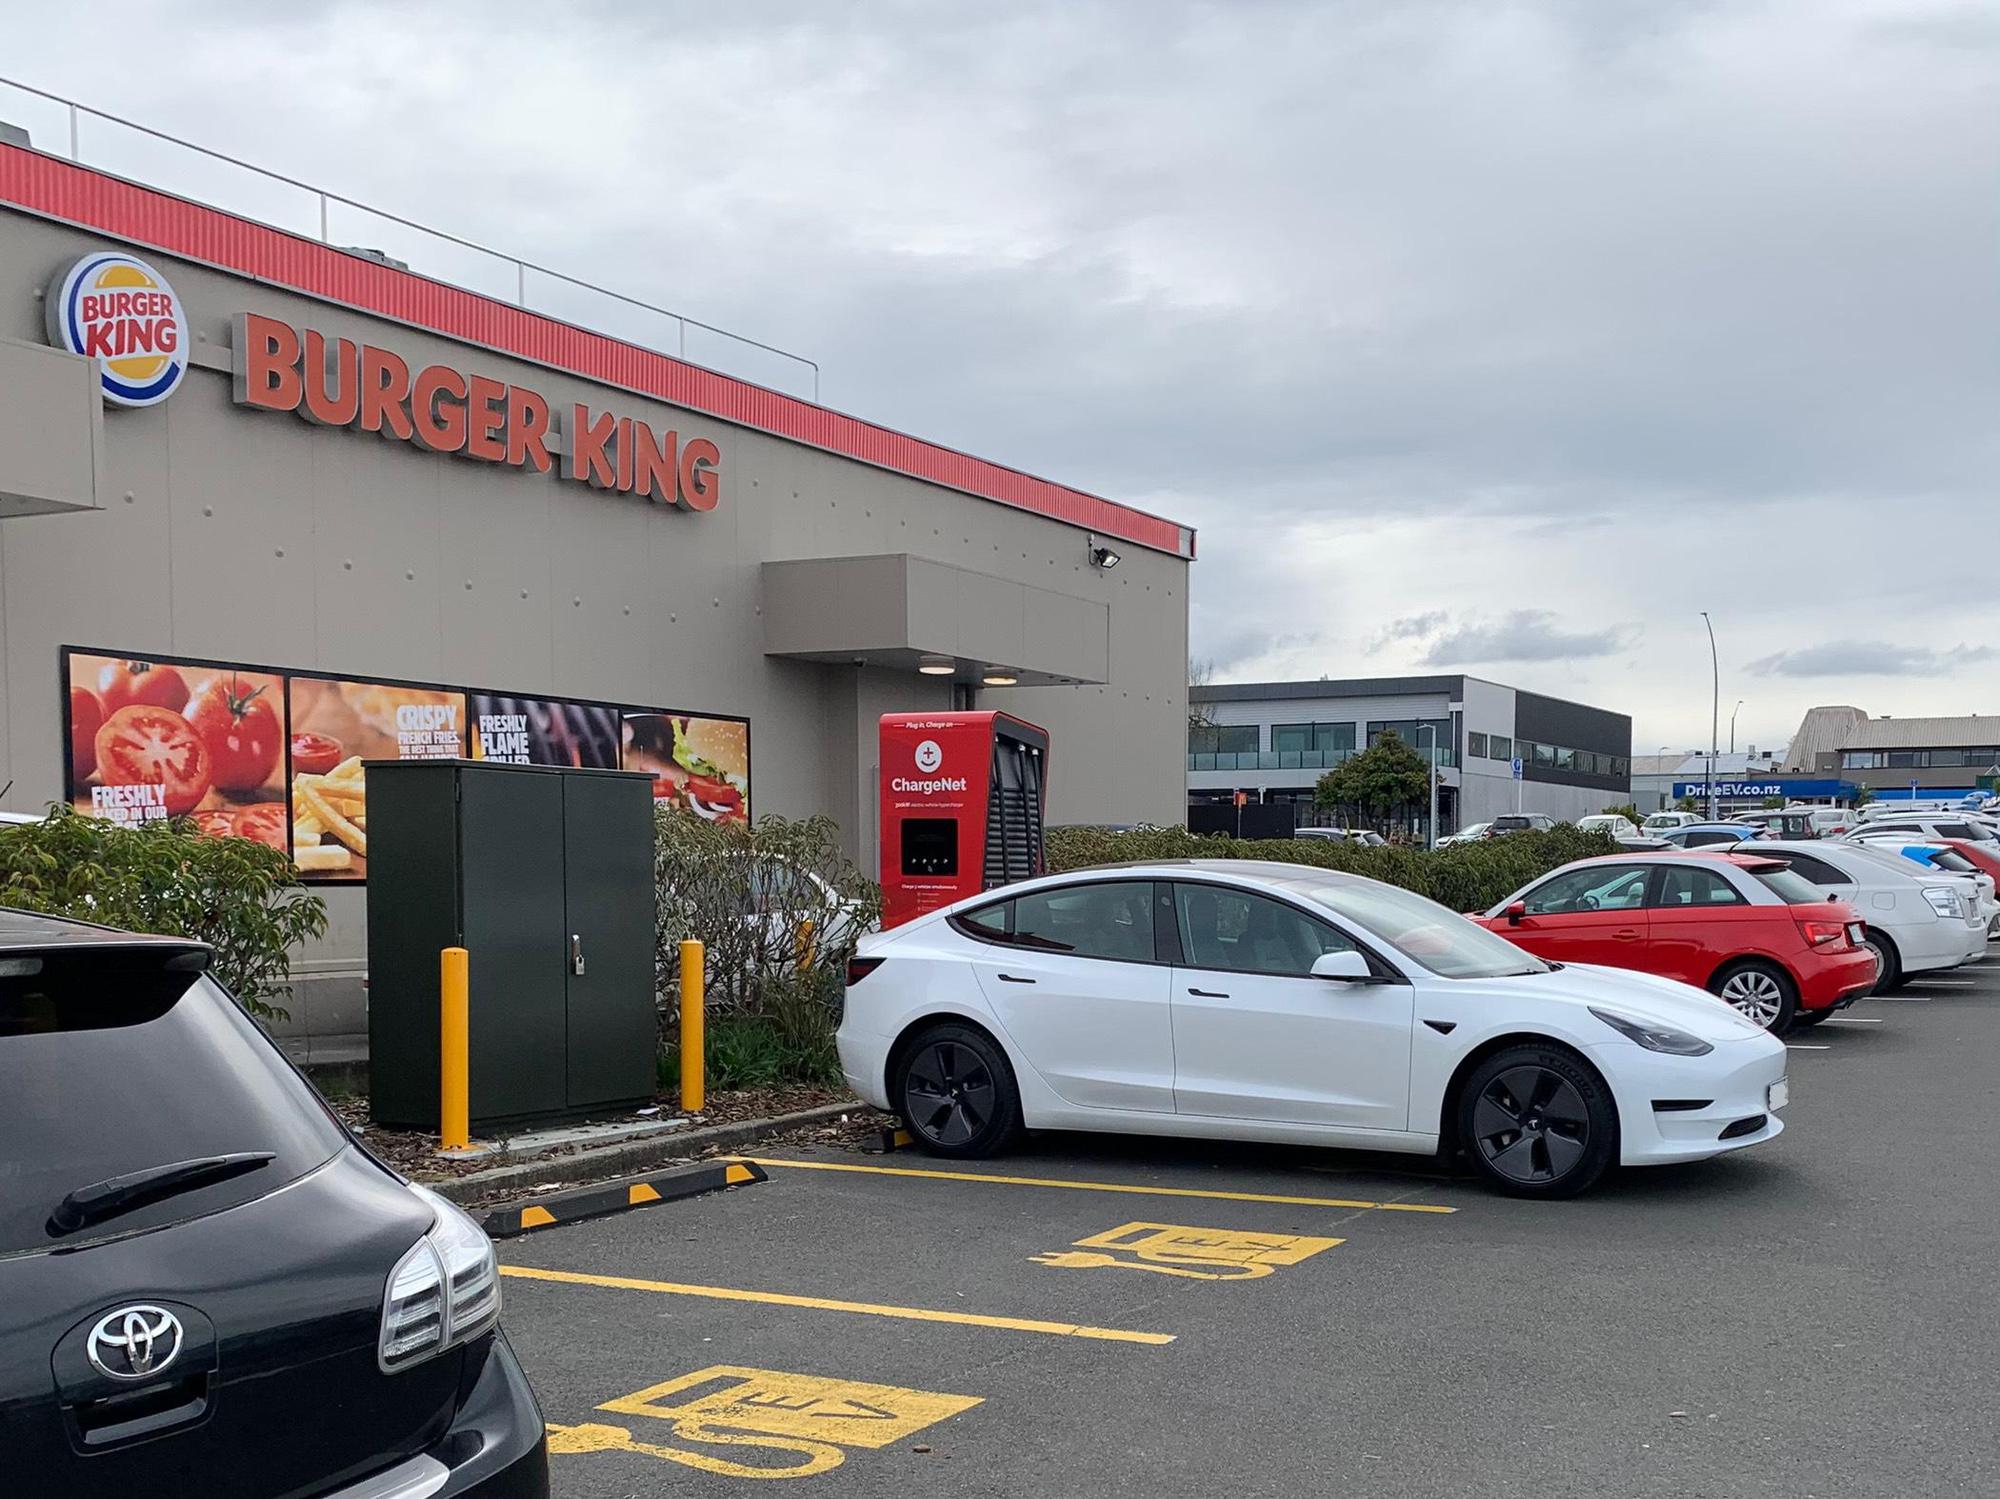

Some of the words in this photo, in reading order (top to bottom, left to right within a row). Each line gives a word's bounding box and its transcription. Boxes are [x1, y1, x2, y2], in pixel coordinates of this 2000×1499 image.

[82, 291, 174, 322] BURGER
[86, 318, 177, 358] KING
[238, 311, 552, 474] BURGER
[567, 402, 721, 512] KING
[396, 704, 457, 731] CRISPY
[479, 714, 527, 732] FRESHLY
[398, 731, 432, 745] FRENCH
[480, 732, 530, 755] FLAME
[91, 784, 166, 809] FRESHLY
[891, 777, 967, 795] ChargeNet
[130, 807, 143, 820] IN
[144, 806, 168, 820] OUR
